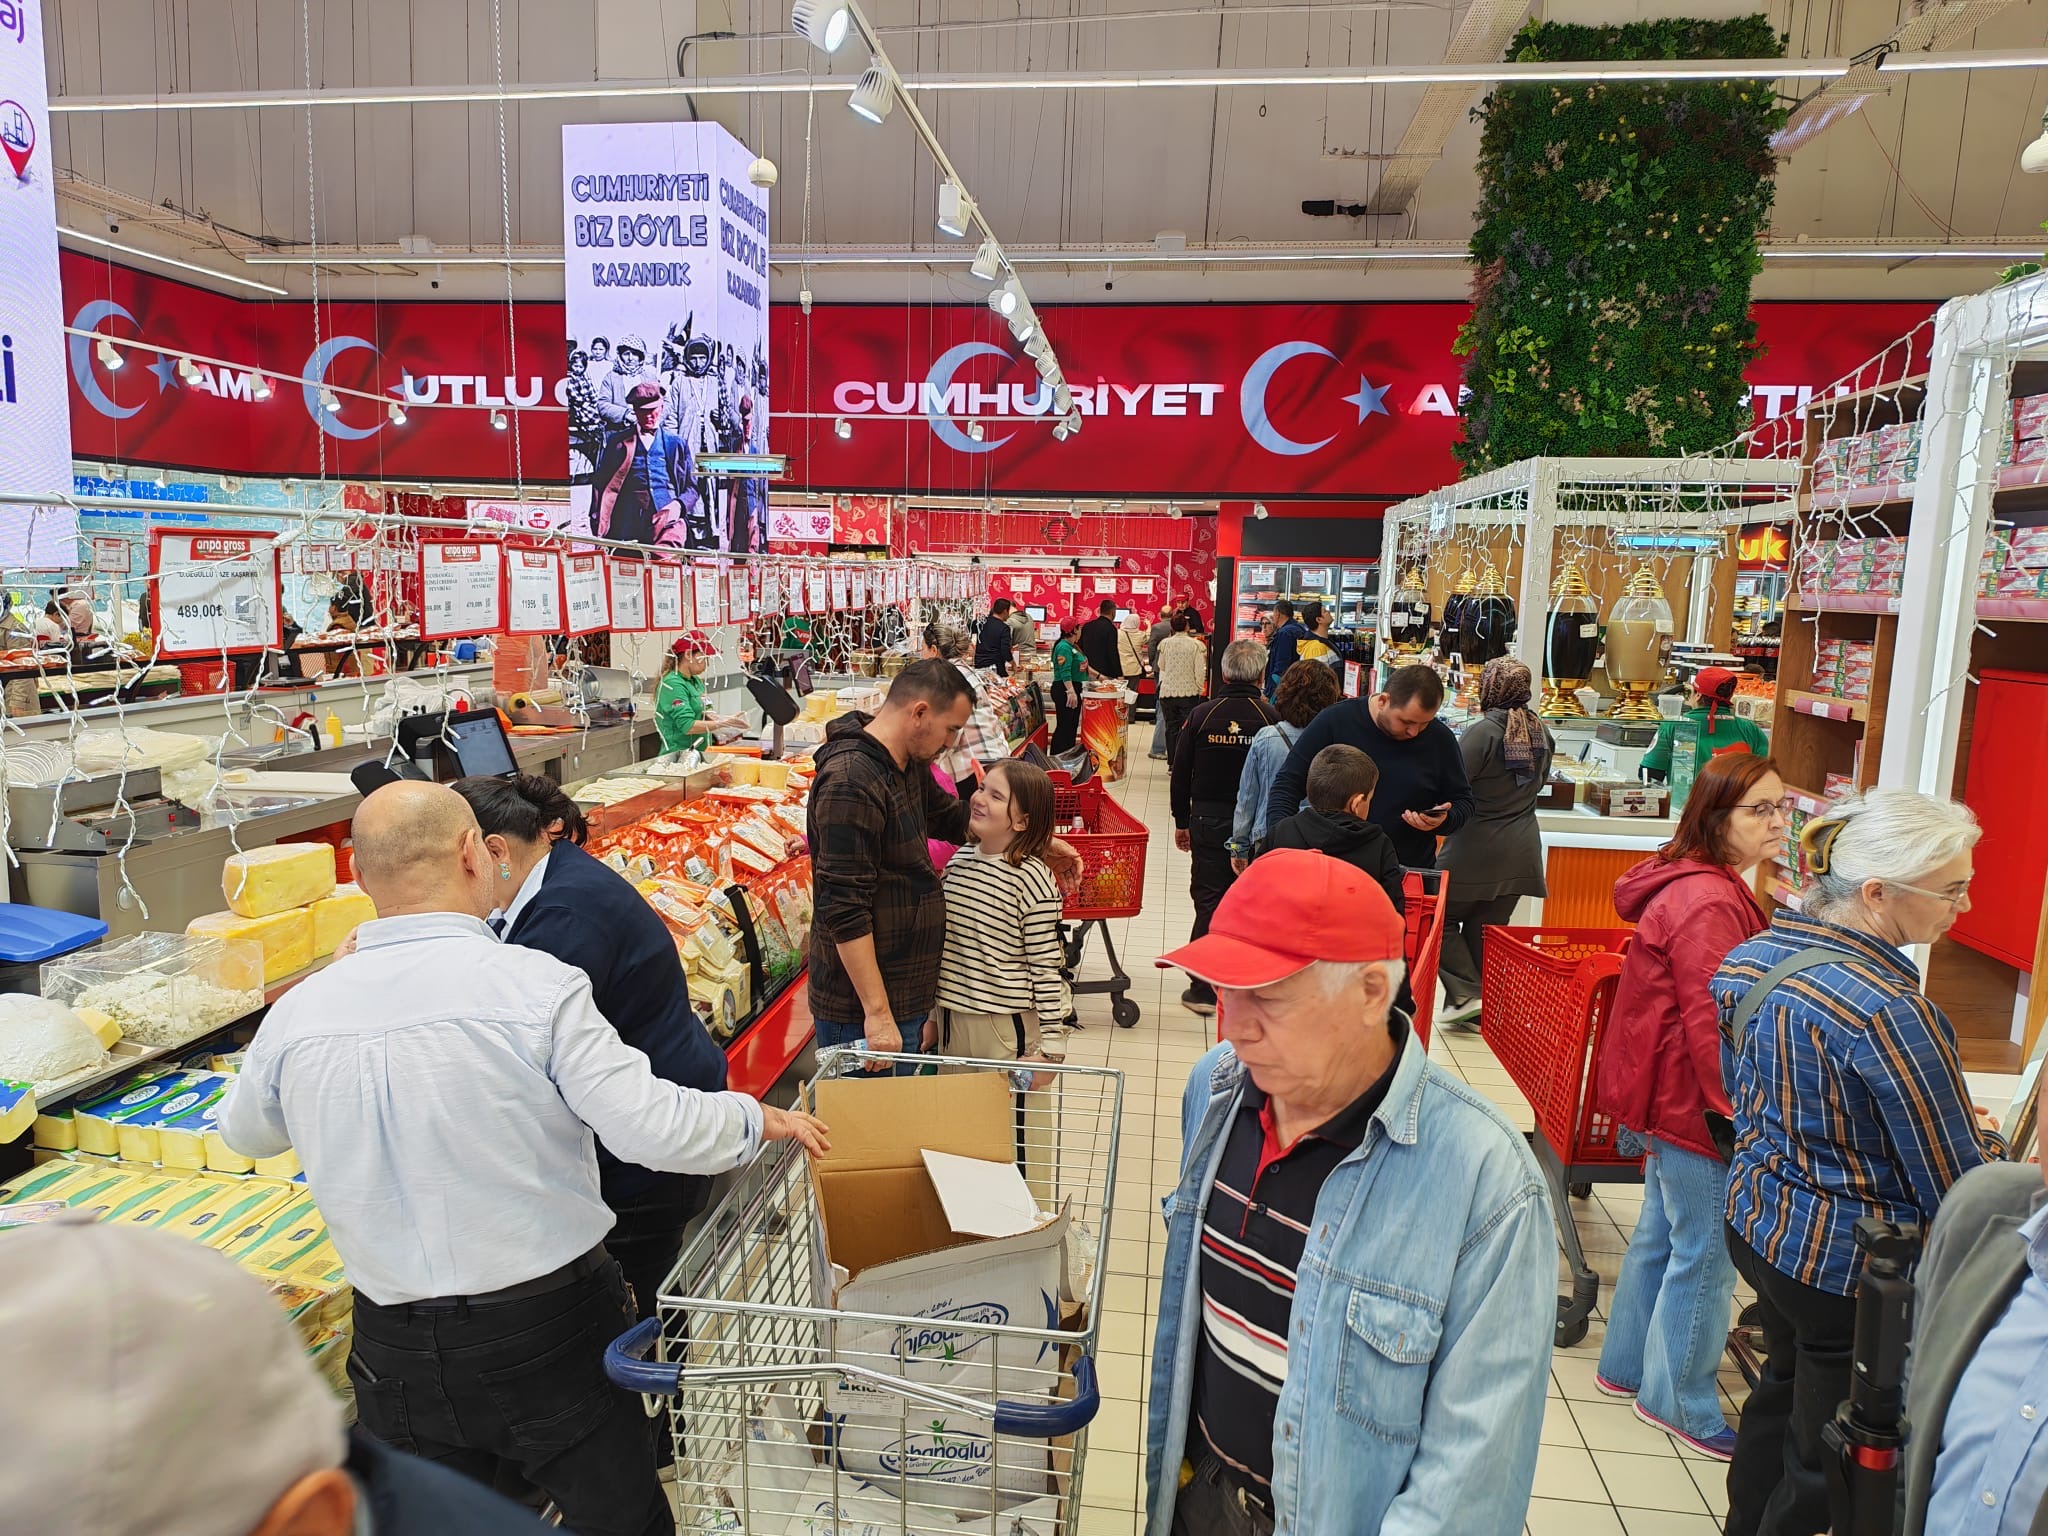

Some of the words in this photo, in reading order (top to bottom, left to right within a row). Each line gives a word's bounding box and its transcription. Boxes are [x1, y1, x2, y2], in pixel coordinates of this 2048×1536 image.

[571, 173, 710, 203] CUMHURİYETİ
[574, 214, 614, 247] BİZ
[618, 214, 708, 247] BÖYLE
[592, 262, 692, 287] KAZANDIK
[833, 376, 1225, 416] CUMHURİYET
[223, 540, 246, 554] gross
[1207, 734, 1237, 745] SOLO
[1238, 735, 1255, 745] TÜ
